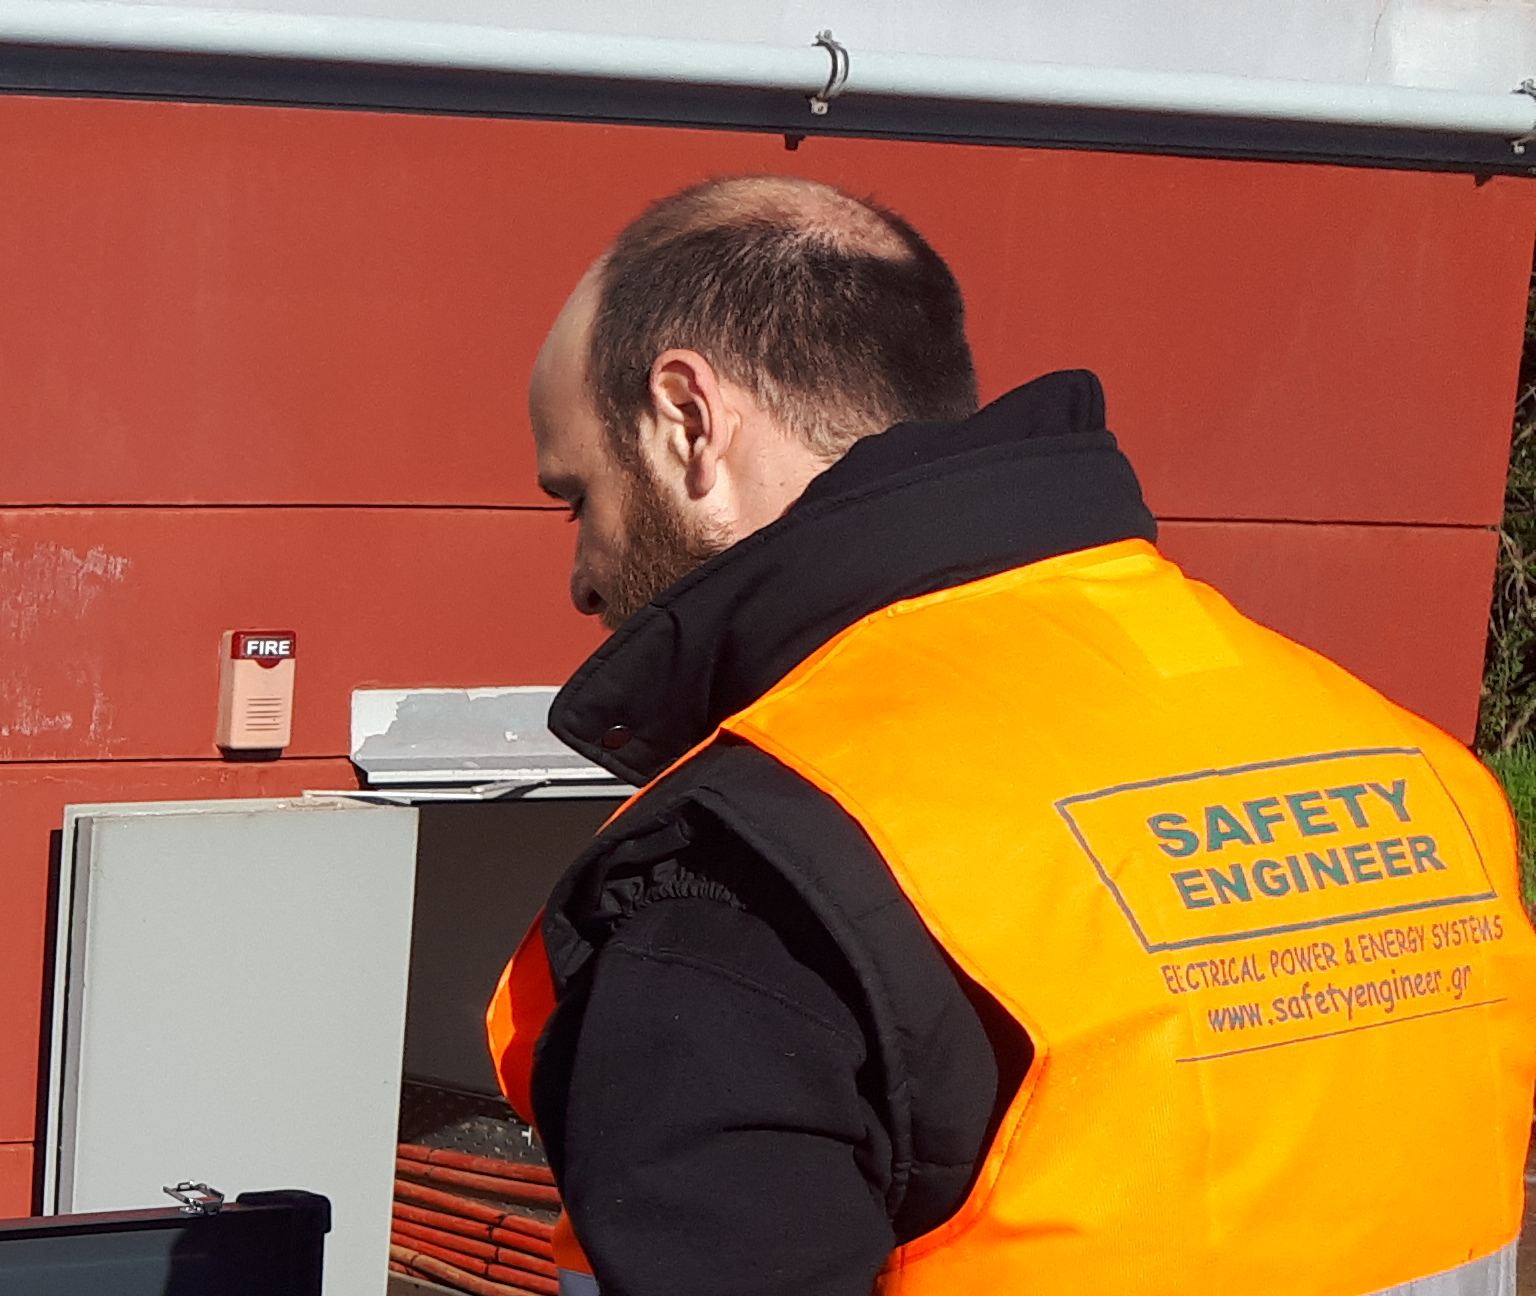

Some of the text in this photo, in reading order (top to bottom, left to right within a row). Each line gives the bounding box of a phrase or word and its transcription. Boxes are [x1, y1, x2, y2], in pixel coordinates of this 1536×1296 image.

[245, 639, 291, 656] FIRE
[1146, 778, 1415, 859] SAFETY
[1170, 833, 1448, 910] ENGINEER
[1269, 941, 1340, 978] POWER
[1344, 937, 1357, 965] &
[1357, 924, 1425, 963] ENERGY
[1431, 914, 1504, 950] SYSTEMS
[1207, 964, 1472, 1033] www.safetyengineer.gr
